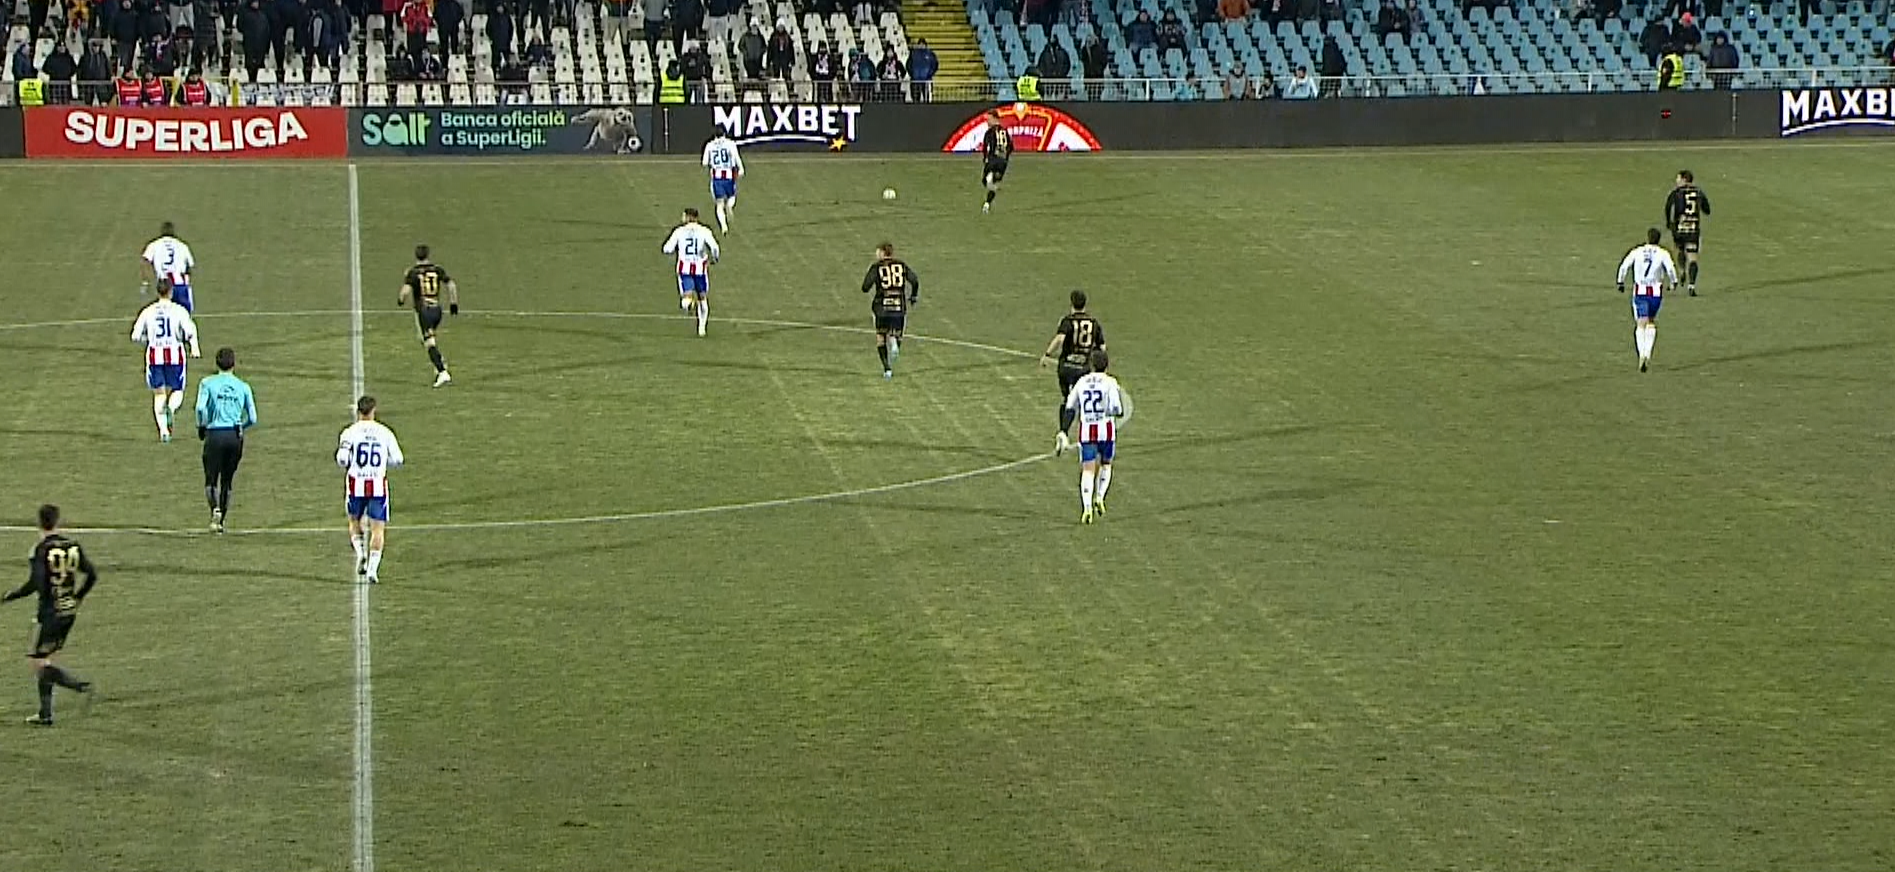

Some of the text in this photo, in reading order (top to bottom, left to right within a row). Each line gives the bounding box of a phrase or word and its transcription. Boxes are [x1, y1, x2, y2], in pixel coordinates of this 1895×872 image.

[441, 110, 566, 127] Banca oficială
[1782, 90, 1895, 127] MAXB
[65, 111, 308, 152] SUPERLIGA
[362, 112, 431, 145] Salt
[713, 105, 861, 141] MAXBET
[441, 130, 547, 148] a SuperLigii.
[1684, 192, 1697, 215] 5
[164, 247, 175, 265] 3
[685, 238, 698, 255] 21
[879, 264, 904, 289] 98
[1643, 258, 1653, 278] 7
[417, 271, 439, 296] 10
[156, 316, 171, 338] 31
[1072, 319, 1093, 347] 18
[1083, 390, 1104, 413] 22
[356, 442, 381, 469] 66
